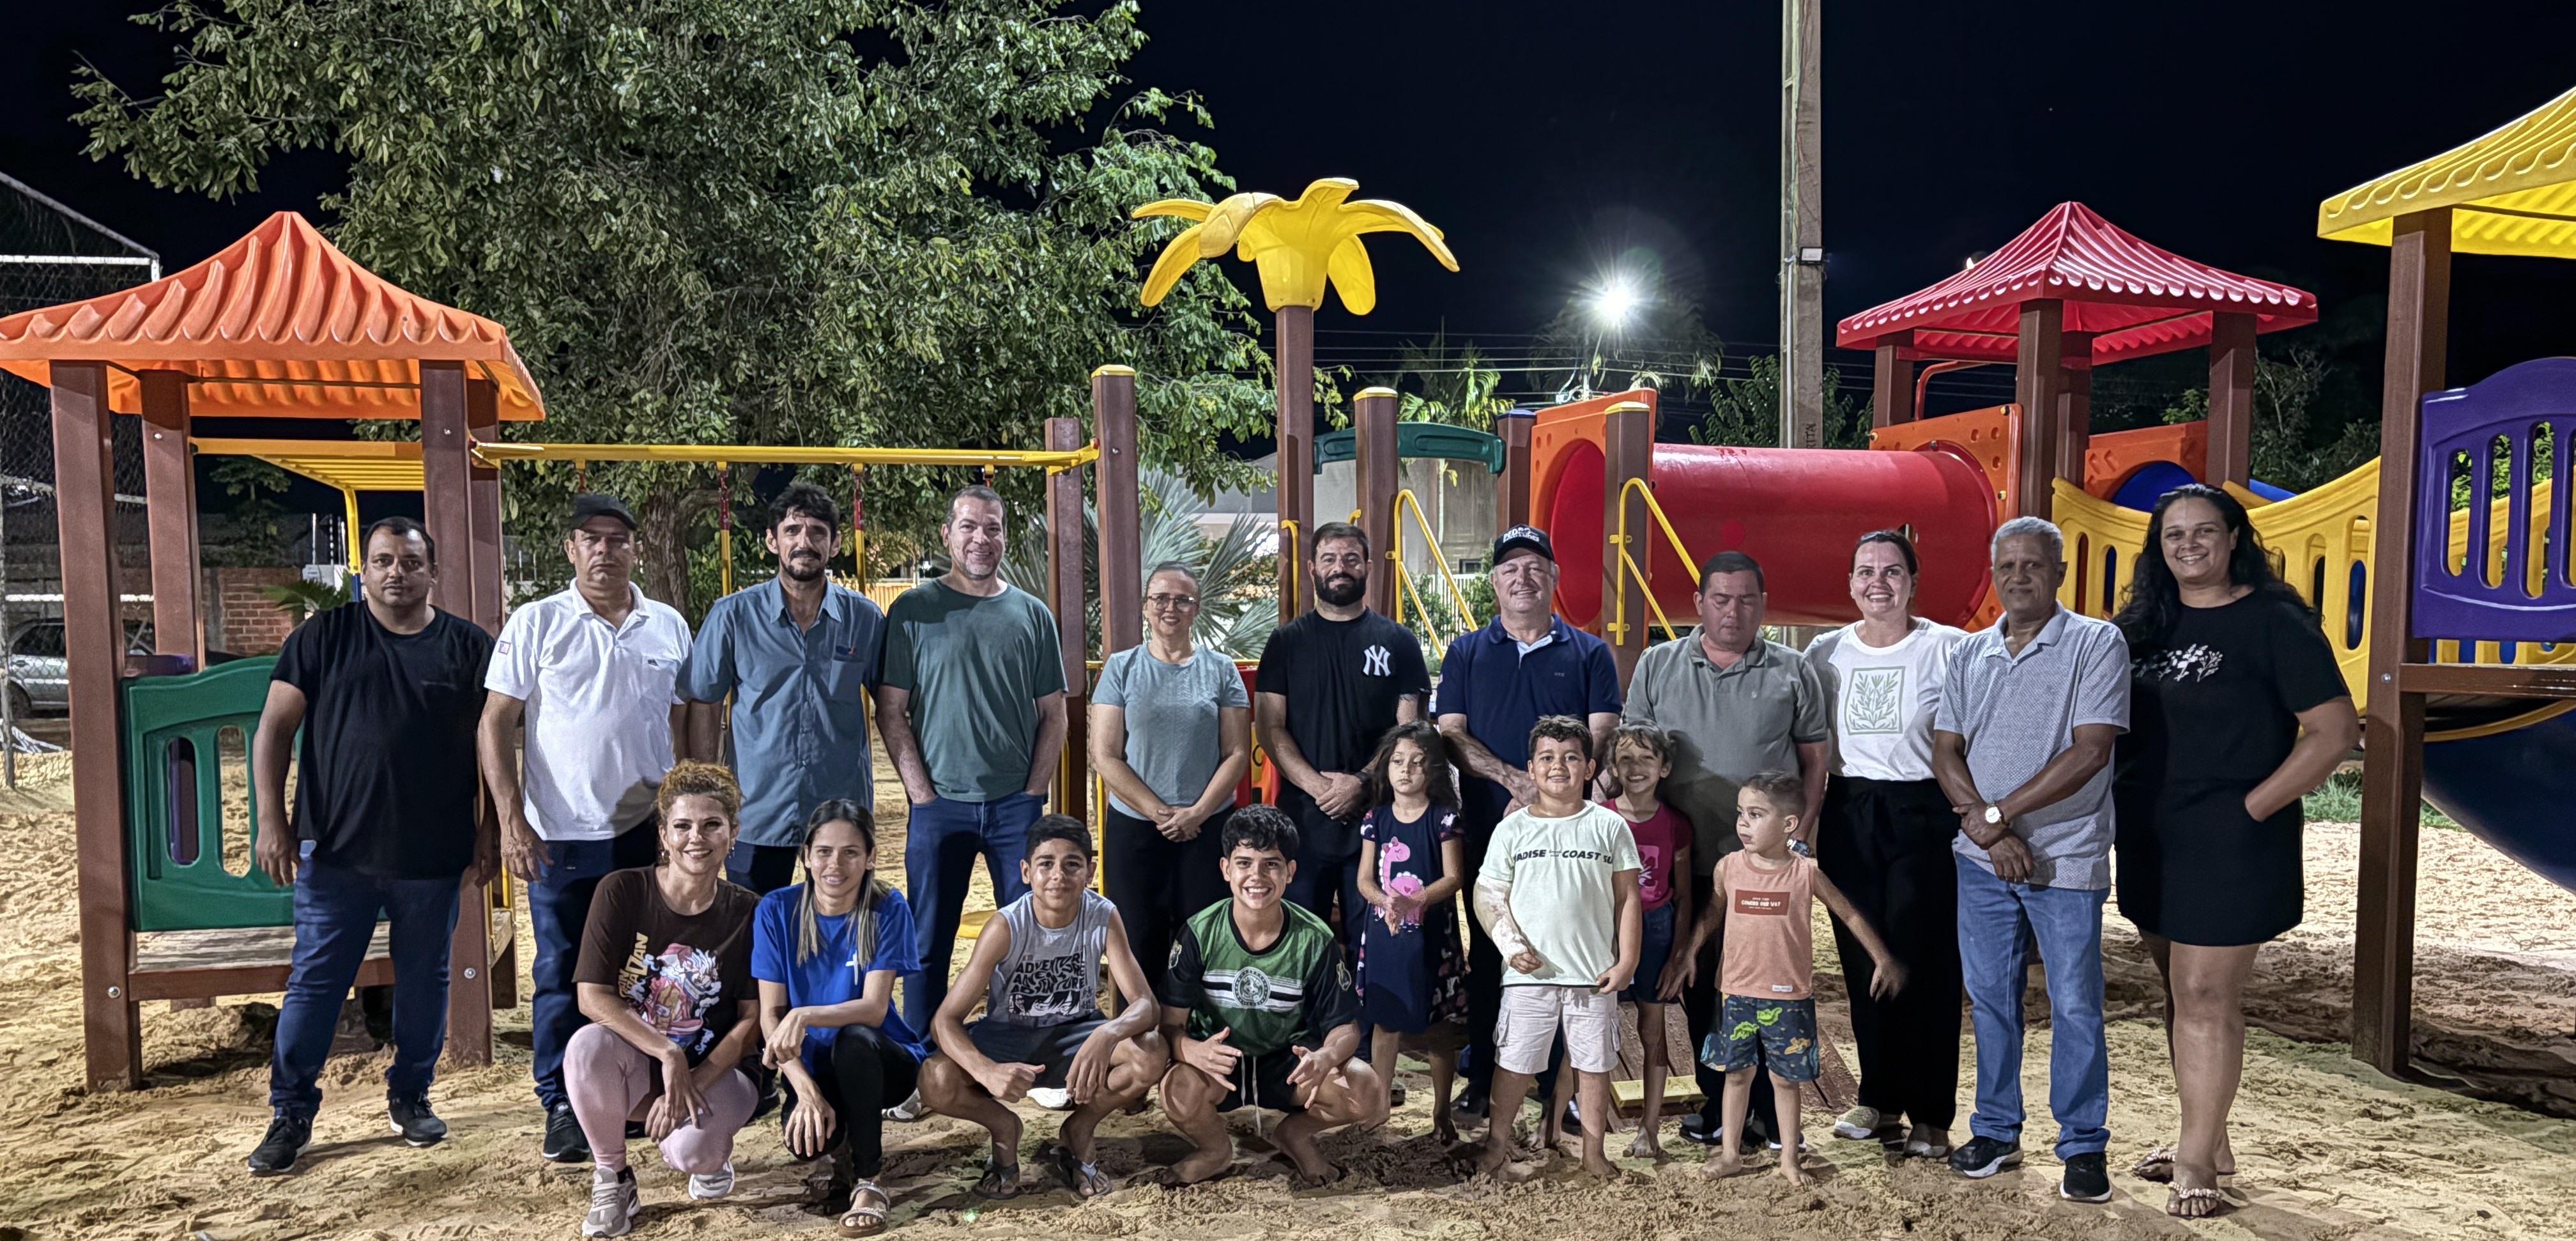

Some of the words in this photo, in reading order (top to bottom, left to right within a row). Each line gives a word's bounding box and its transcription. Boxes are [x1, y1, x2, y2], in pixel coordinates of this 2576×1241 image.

[1363, 644, 1391, 677] NY
[1514, 849, 1547, 862] ADISE
[1562, 850, 1602, 861] COAST
